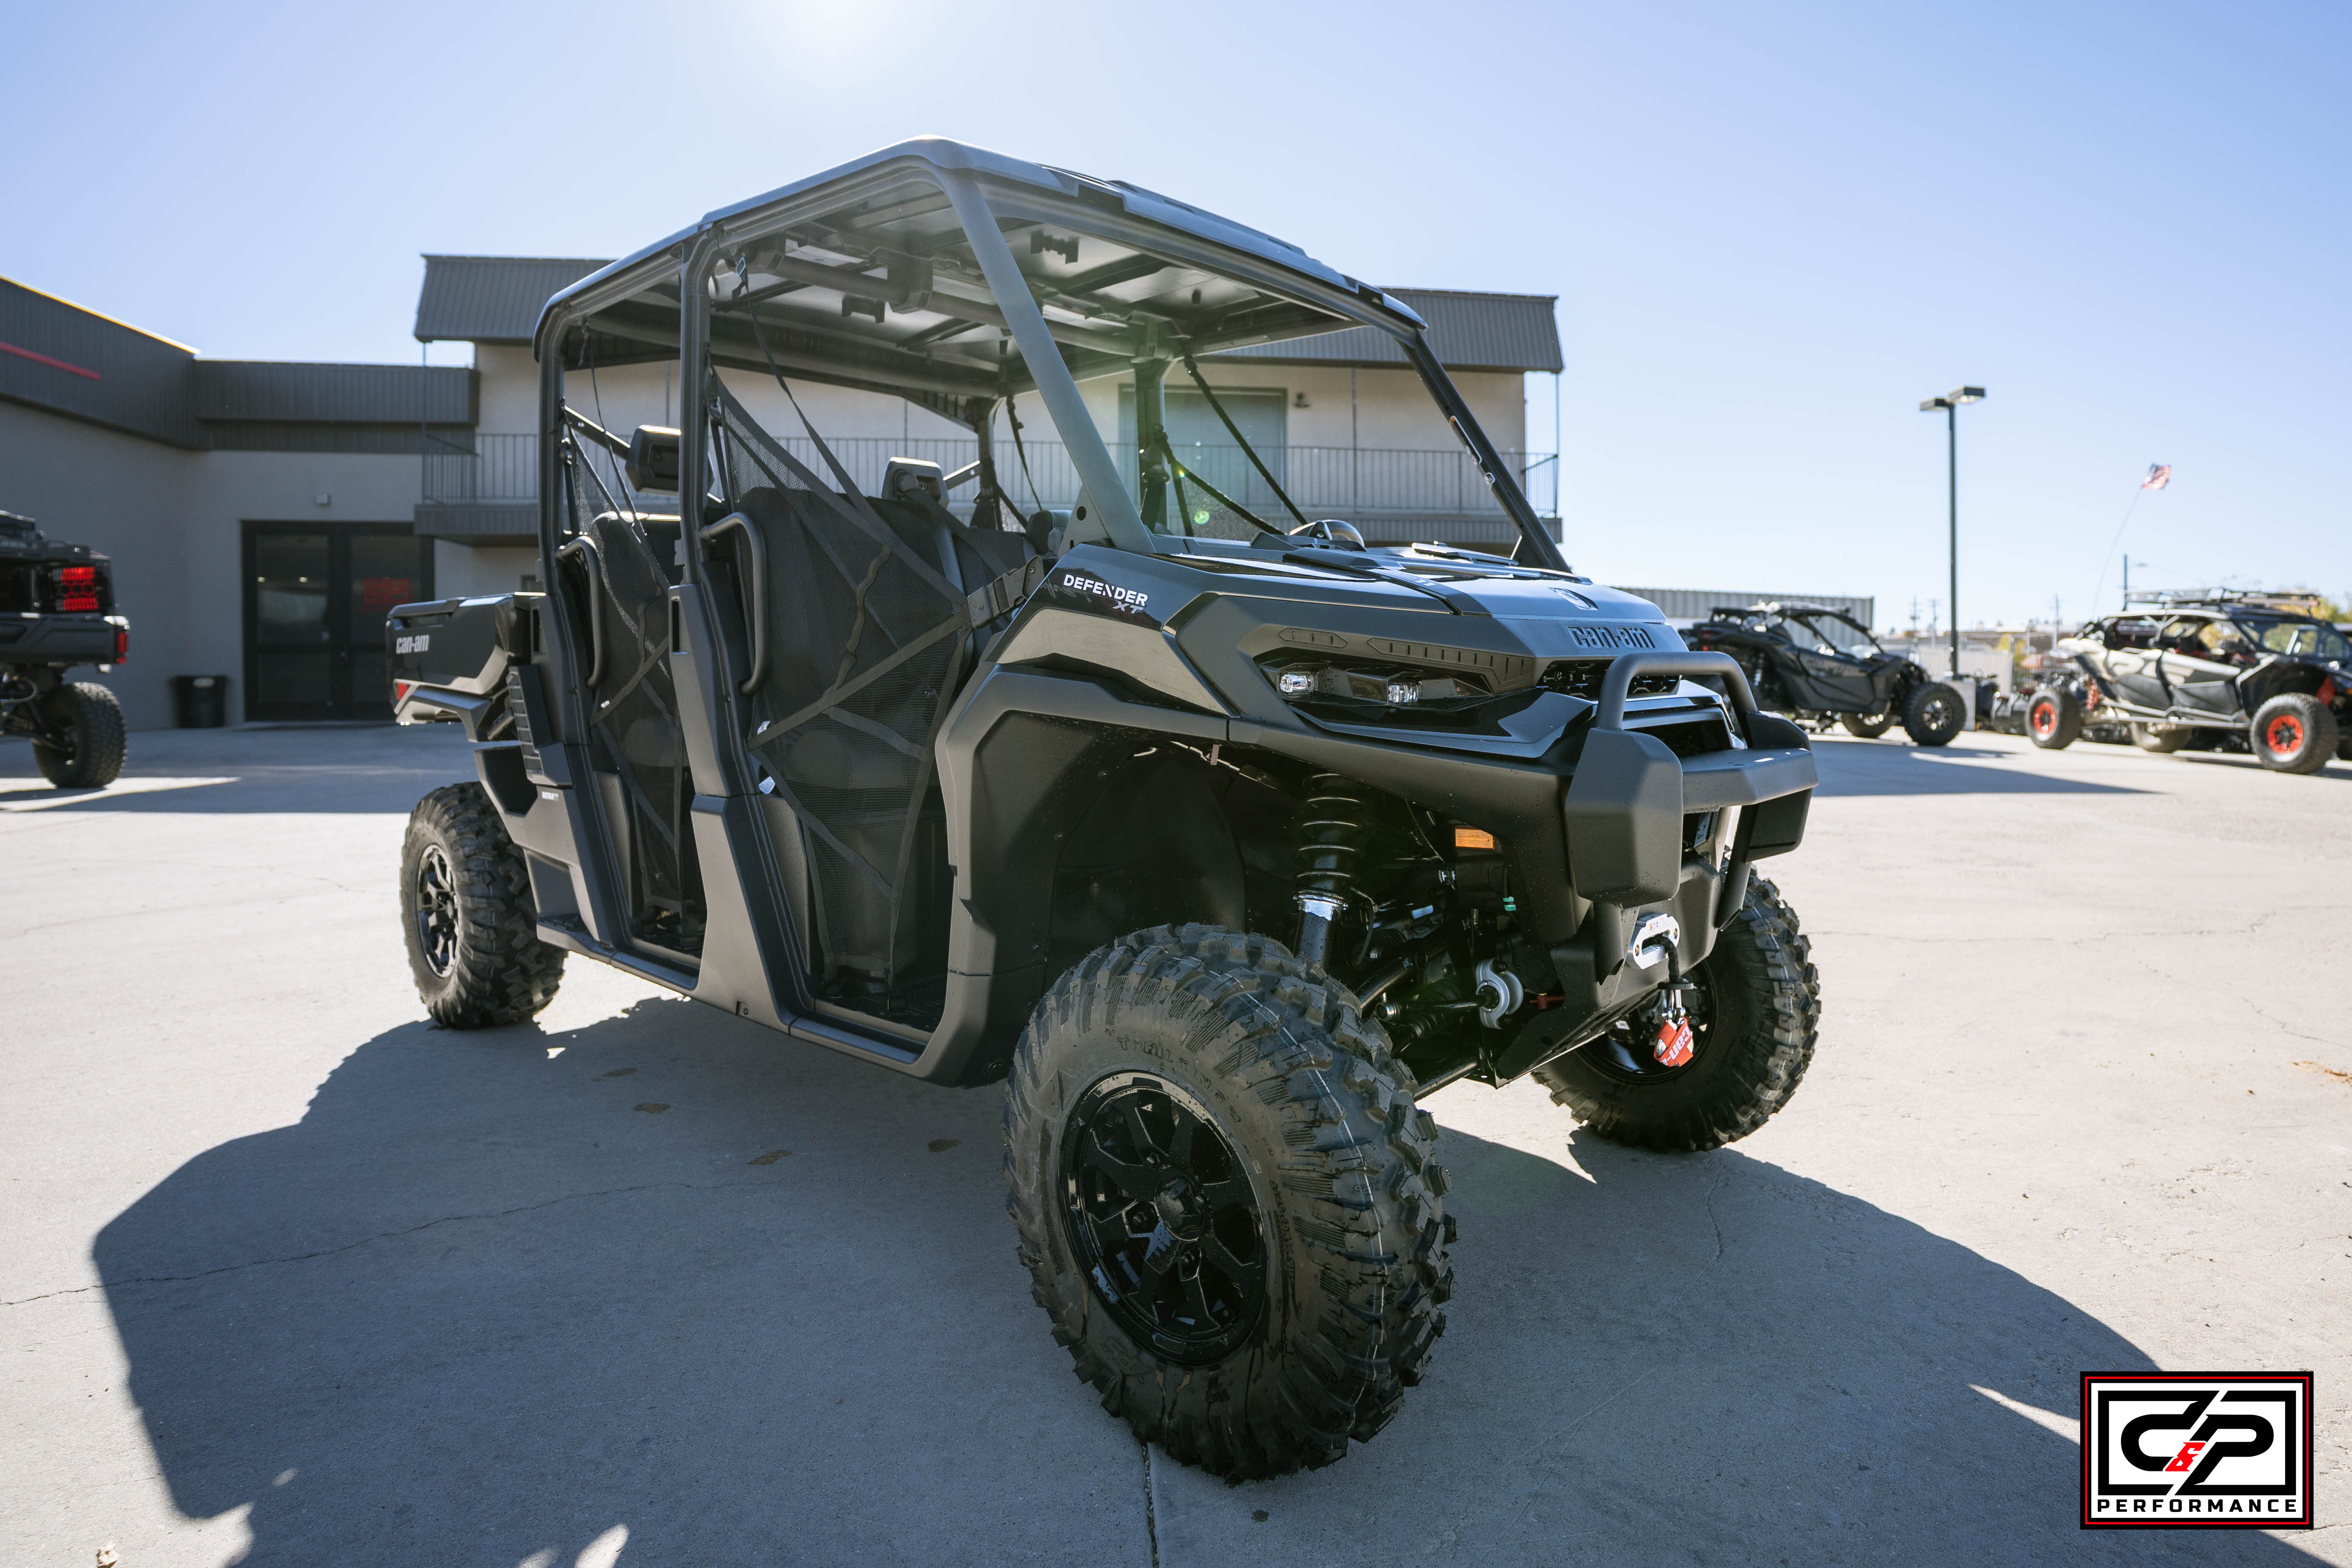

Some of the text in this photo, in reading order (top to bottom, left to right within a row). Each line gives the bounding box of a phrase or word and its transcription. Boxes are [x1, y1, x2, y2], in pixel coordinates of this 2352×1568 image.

[1063, 574, 1148, 606] DEFENDER
[1112, 601, 1144, 614] XT
[396, 634, 429, 654] can-am
[1567, 627, 1656, 649] can-am
